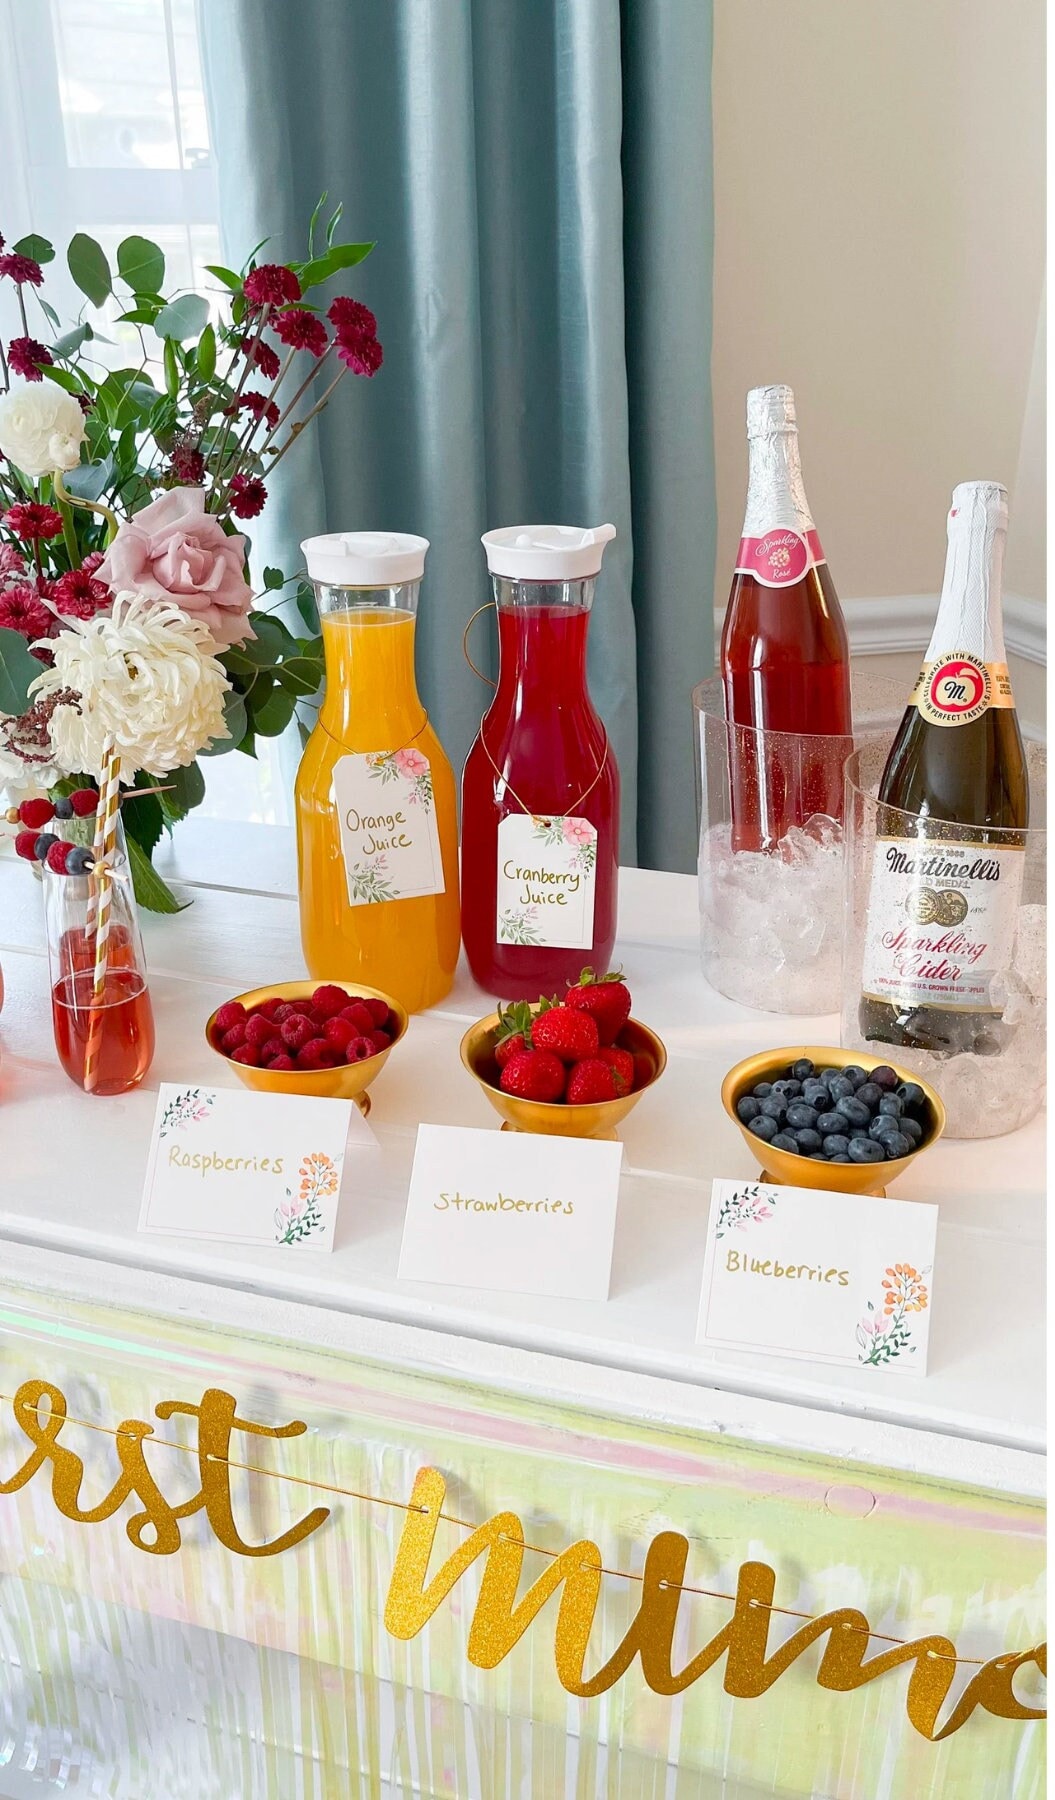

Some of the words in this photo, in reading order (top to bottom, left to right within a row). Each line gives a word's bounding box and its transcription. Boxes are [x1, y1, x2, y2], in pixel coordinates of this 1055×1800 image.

[755, 533, 800, 557] Sparkling
[945, 652, 965, 662] WITH
[967, 655, 992, 701] MARTINELLI'S
[925, 702, 932, 711] IN
[930, 708, 961, 721] PERFECT
[963, 704, 984, 720] TASTE
[346, 808, 407, 832] Orange
[362, 833, 412, 855] Juice
[503, 860, 580, 892] Cranberry
[520, 884, 568, 905] Juice
[881, 927, 988, 964] Sparkling
[893, 951, 963, 981] Cider
[168, 1144, 284, 1178] Raspberries
[433, 1191, 574, 1215] Strawberries
[725, 1249, 849, 1286] Blueberries
